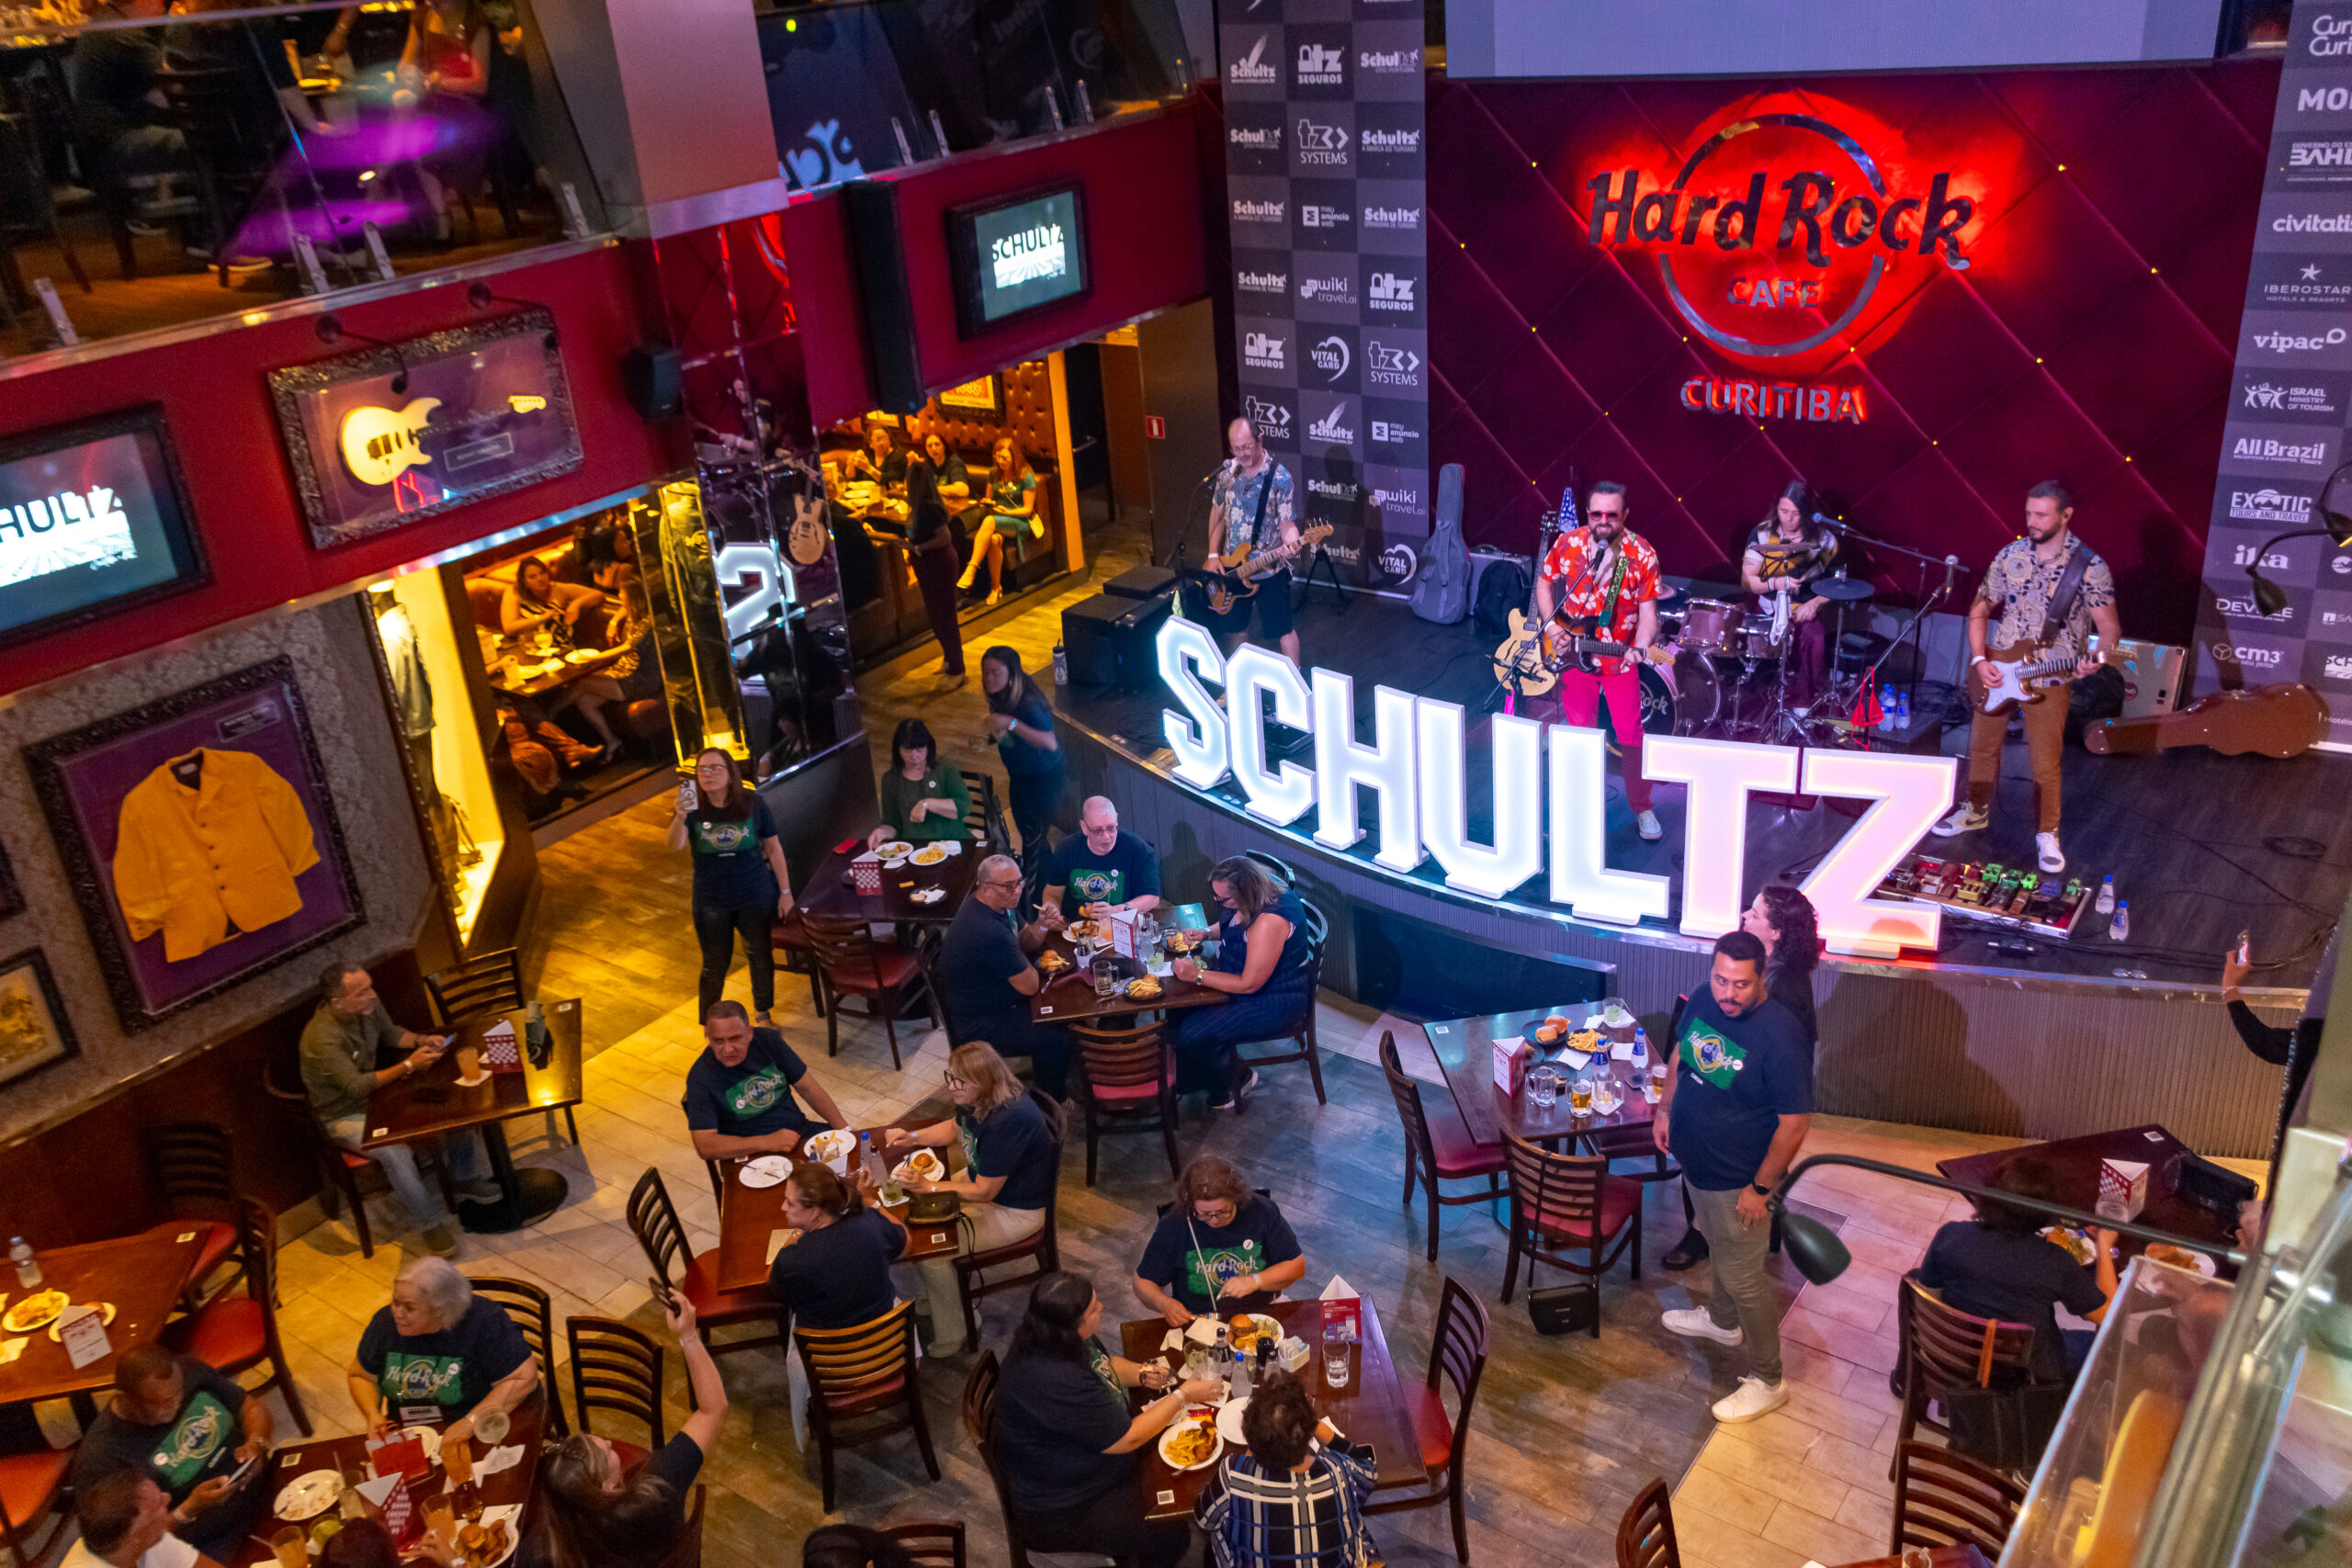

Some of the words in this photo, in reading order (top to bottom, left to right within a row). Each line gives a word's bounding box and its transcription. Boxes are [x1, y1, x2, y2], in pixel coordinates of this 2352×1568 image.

[2312, 15, 2352, 36] Cur
[1230, 63, 1276, 77] Schultz
[1298, 74, 1342, 84] SEGUROS
[2298, 88, 2352, 110] MO
[1362, 130, 1417, 145] Schultz
[1301, 152, 1347, 164] SYSTEMS
[2290, 149, 2352, 165] BAHI
[1234, 200, 1283, 216] Schultz
[1364, 208, 1418, 222] Schultz
[1586, 170, 1768, 251] Hard
[1778, 171, 1976, 270] Rock
[992, 224, 1064, 262] SCHULTZ
[1238, 272, 1285, 288] Schultz
[1317, 277, 1348, 292] wiki
[1727, 276, 1821, 309] CAFE
[2264, 285, 2352, 295] IBEROSTAR
[1318, 293, 1357, 304] travel.ai
[1370, 300, 1414, 311] SEGUROS
[1245, 357, 1284, 369] SEGUROS
[1311, 351, 1340, 362] VITAL
[1317, 361, 1340, 370] CARD
[1371, 371, 1418, 386] SYSTEMS
[2290, 388, 2325, 397] ISRAEL
[1680, 379, 1861, 424] CURITIBA
[1261, 424, 1290, 439] STEMS
[1309, 423, 1352, 440] Schultz
[1390, 435, 1404, 444] web
[2233, 438, 2262, 456] All
[2264, 440, 2325, 459] Brazil
[1387, 489, 1416, 503] wiki
[2232, 509, 2257, 518] TOURS
[2259, 511, 2276, 519] AND
[2278, 512, 2307, 522] TRAVEL
[1378, 557, 1407, 568] VITAL
[1385, 565, 1407, 575] CARD
[2234, 647, 2280, 664] cm3
[1155, 615, 1958, 959] SCHULTZ
[1074, 876, 1097, 889] Hard
[1098, 878, 1118, 891] Rock
[1688, 1031, 1716, 1054] Hard
[1195, 1258, 1227, 1274] Hard
[1227, 1256, 1259, 1273] Rock
